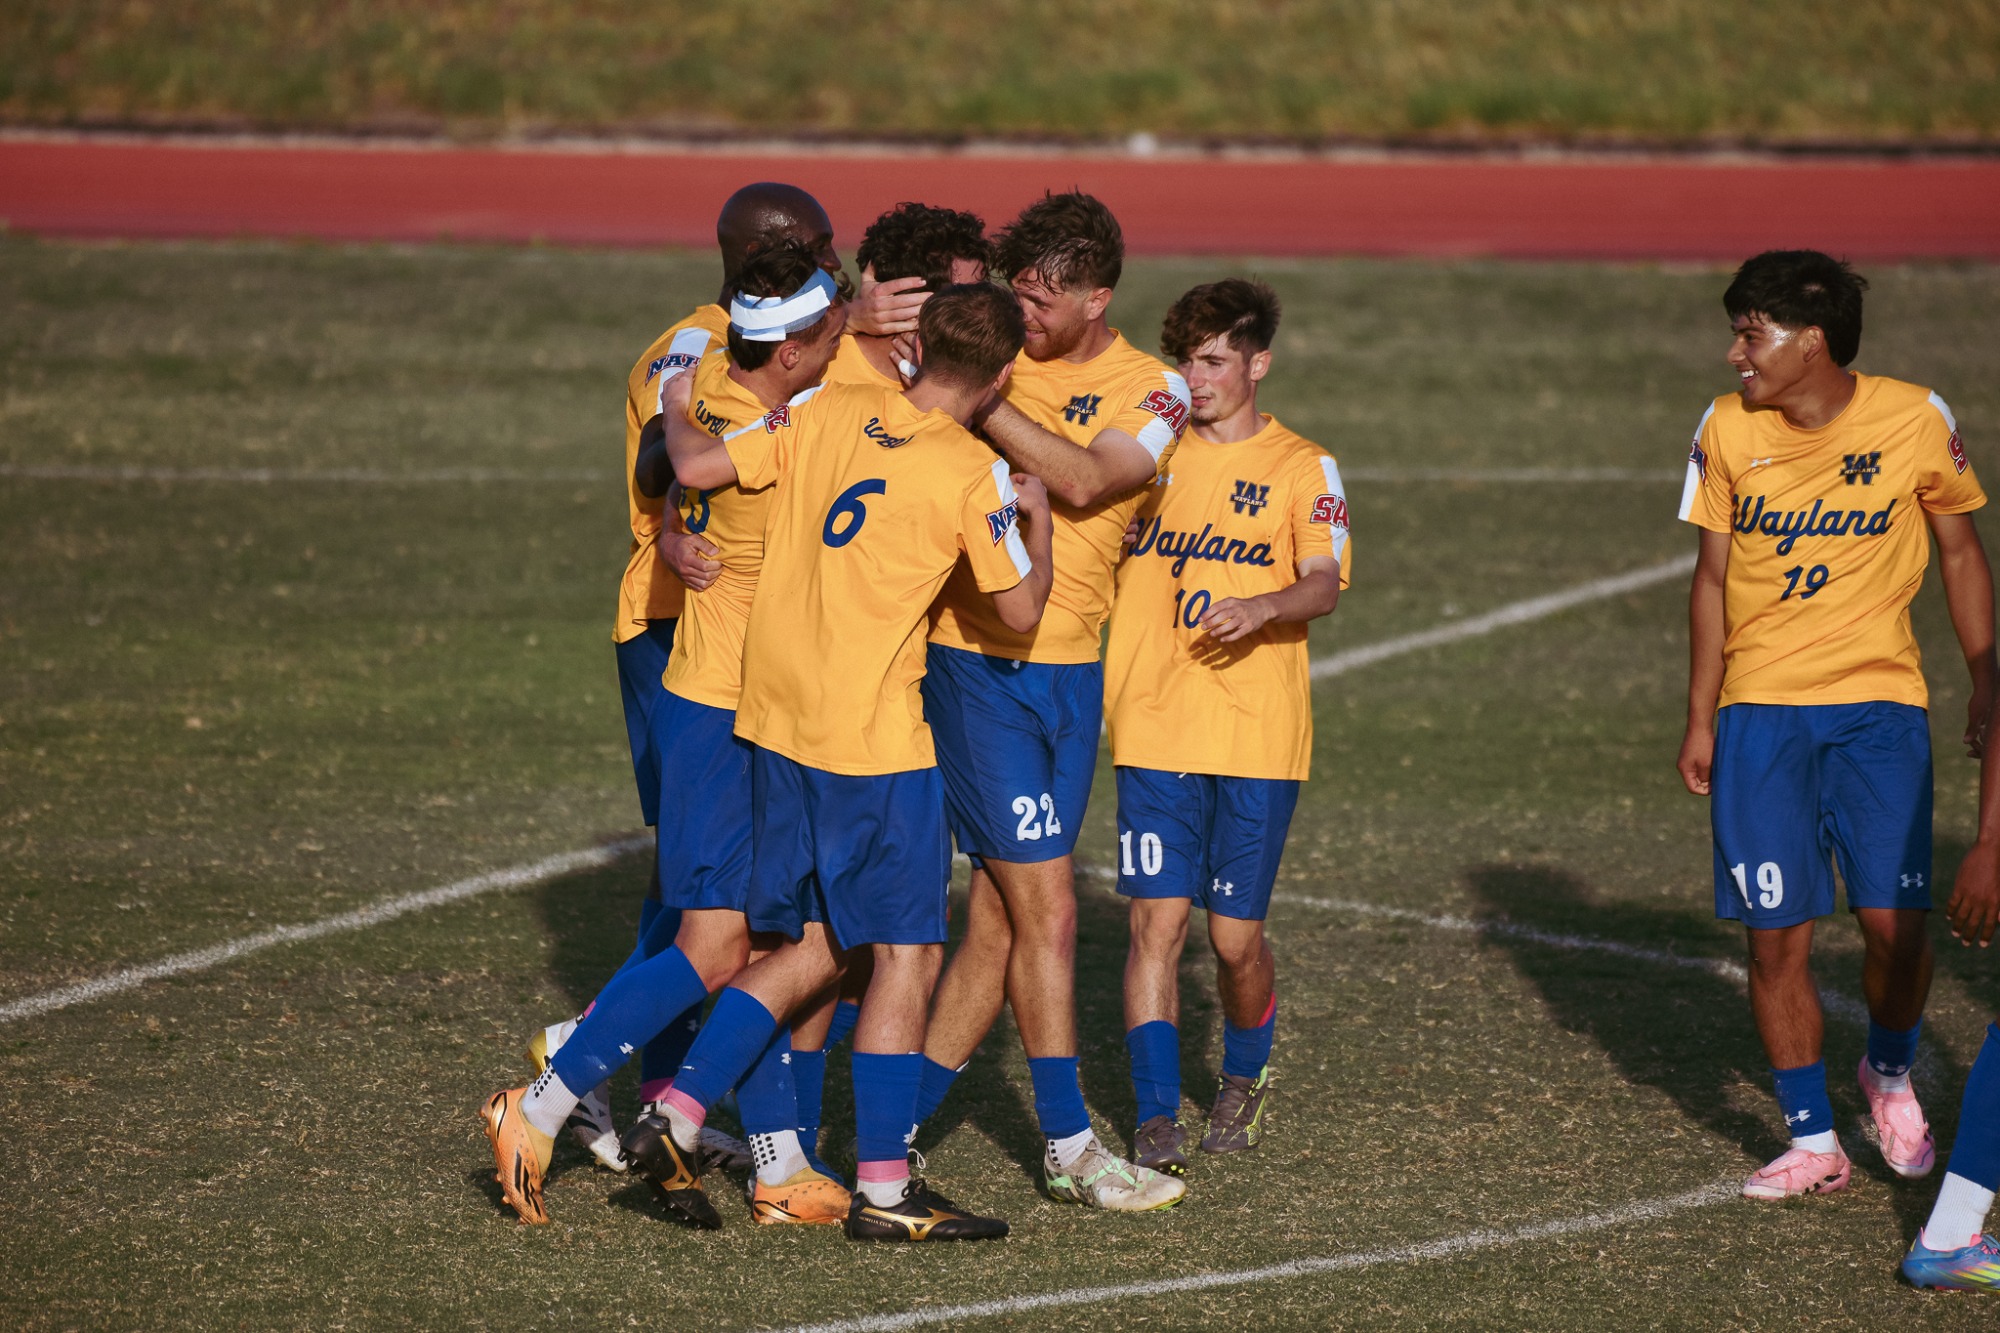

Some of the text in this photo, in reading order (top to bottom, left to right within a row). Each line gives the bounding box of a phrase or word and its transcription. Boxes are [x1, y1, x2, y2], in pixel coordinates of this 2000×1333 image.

[647, 354, 701, 383] NAI
[822, 478, 886, 548] 6
[1309, 493, 1350, 531] SA
[1732, 493, 1898, 557] Wayland
[1780, 564, 1829, 602] 19
[1172, 588, 1212, 630] 10
[1012, 793, 1062, 841] 22
[1120, 831, 1163, 876] 10
[1730, 861, 1784, 910] 19
